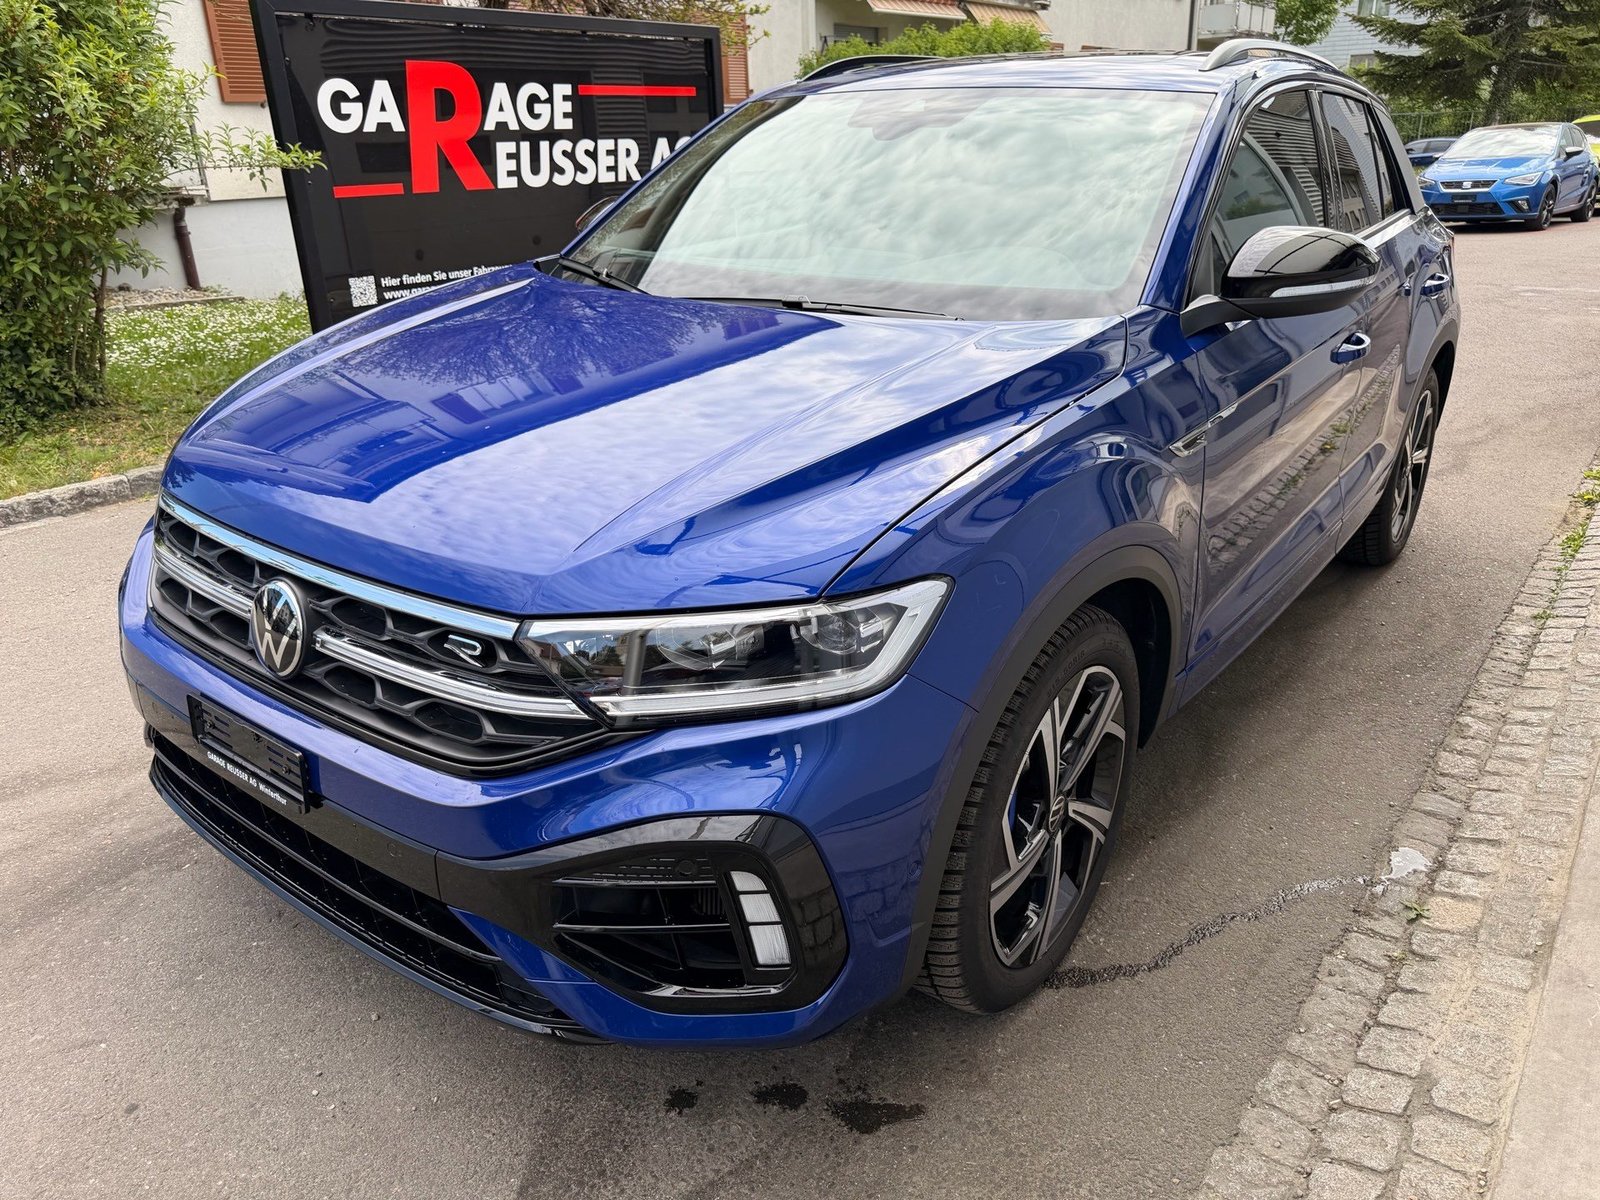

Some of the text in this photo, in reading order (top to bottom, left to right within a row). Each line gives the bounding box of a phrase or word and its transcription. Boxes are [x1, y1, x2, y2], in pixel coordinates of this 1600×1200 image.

[317, 60, 573, 194] GARAGE
[650, 136, 692, 171] A
[381, 277, 401, 287] Hier
[402, 273, 432, 285] finden
[433, 271, 447, 281] Sie
[448, 269, 472, 279] unser
[207, 751, 287, 805] GARAGE REUSSER AG Winterthur
